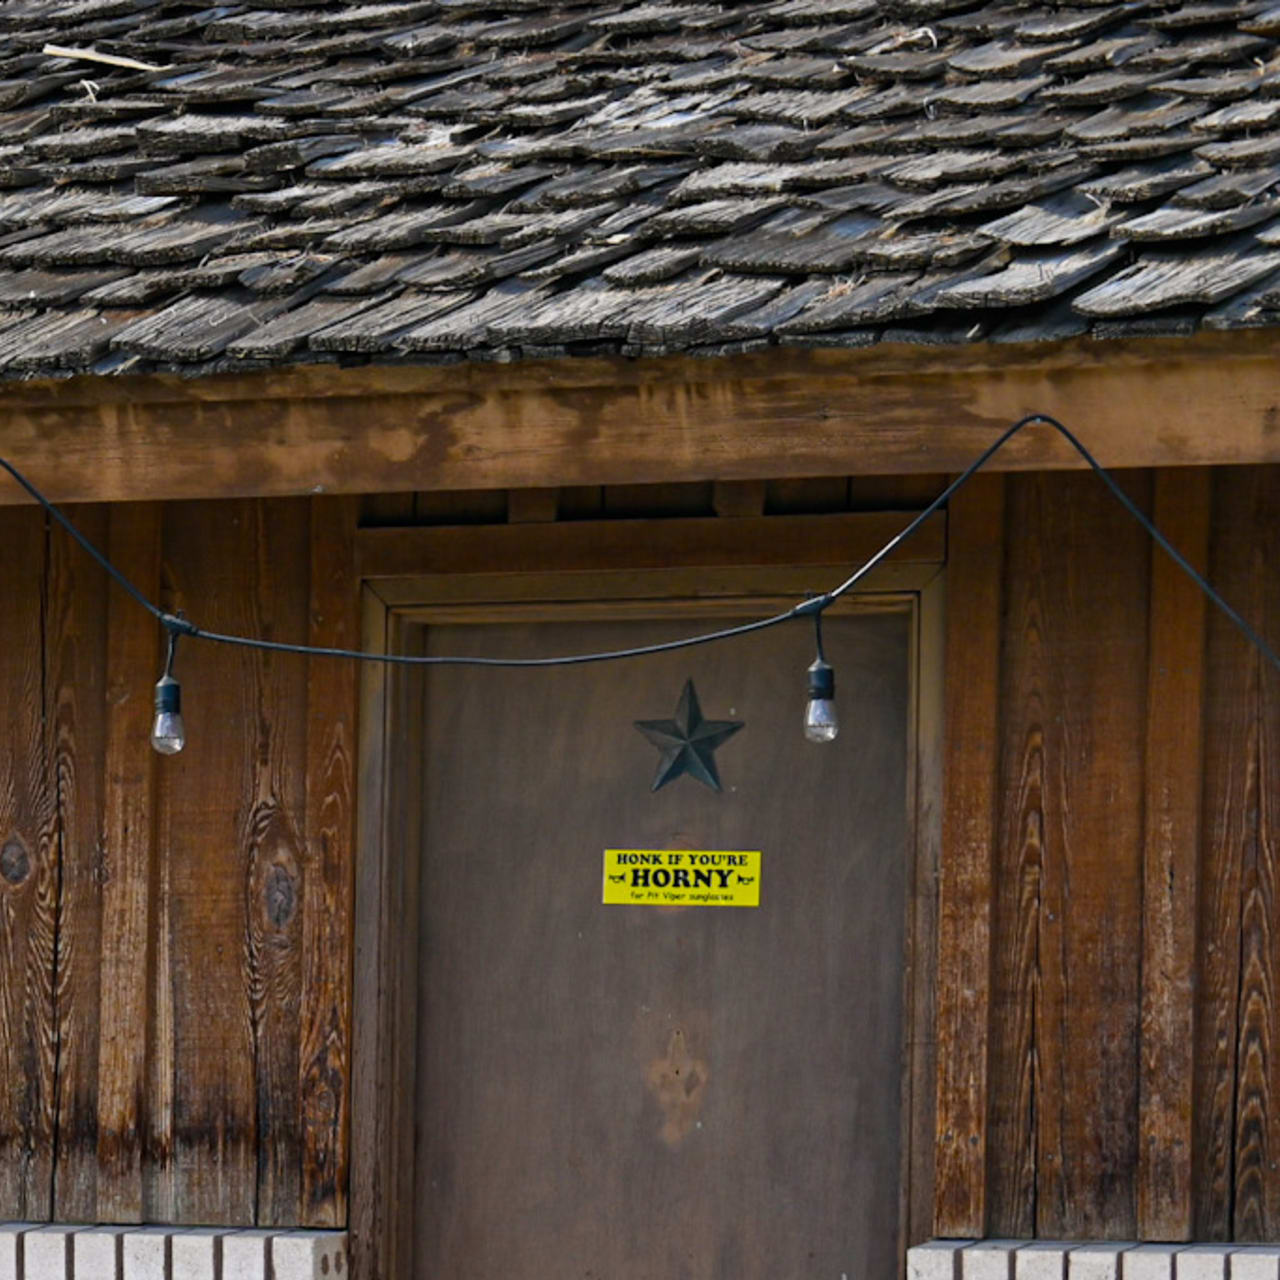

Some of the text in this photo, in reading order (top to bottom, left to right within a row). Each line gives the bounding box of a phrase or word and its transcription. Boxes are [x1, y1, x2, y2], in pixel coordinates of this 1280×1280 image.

[617, 854, 748, 866] HONK IF YOU'RE
[631, 869, 734, 887] HORNY
[663, 893, 685, 901] Viper
